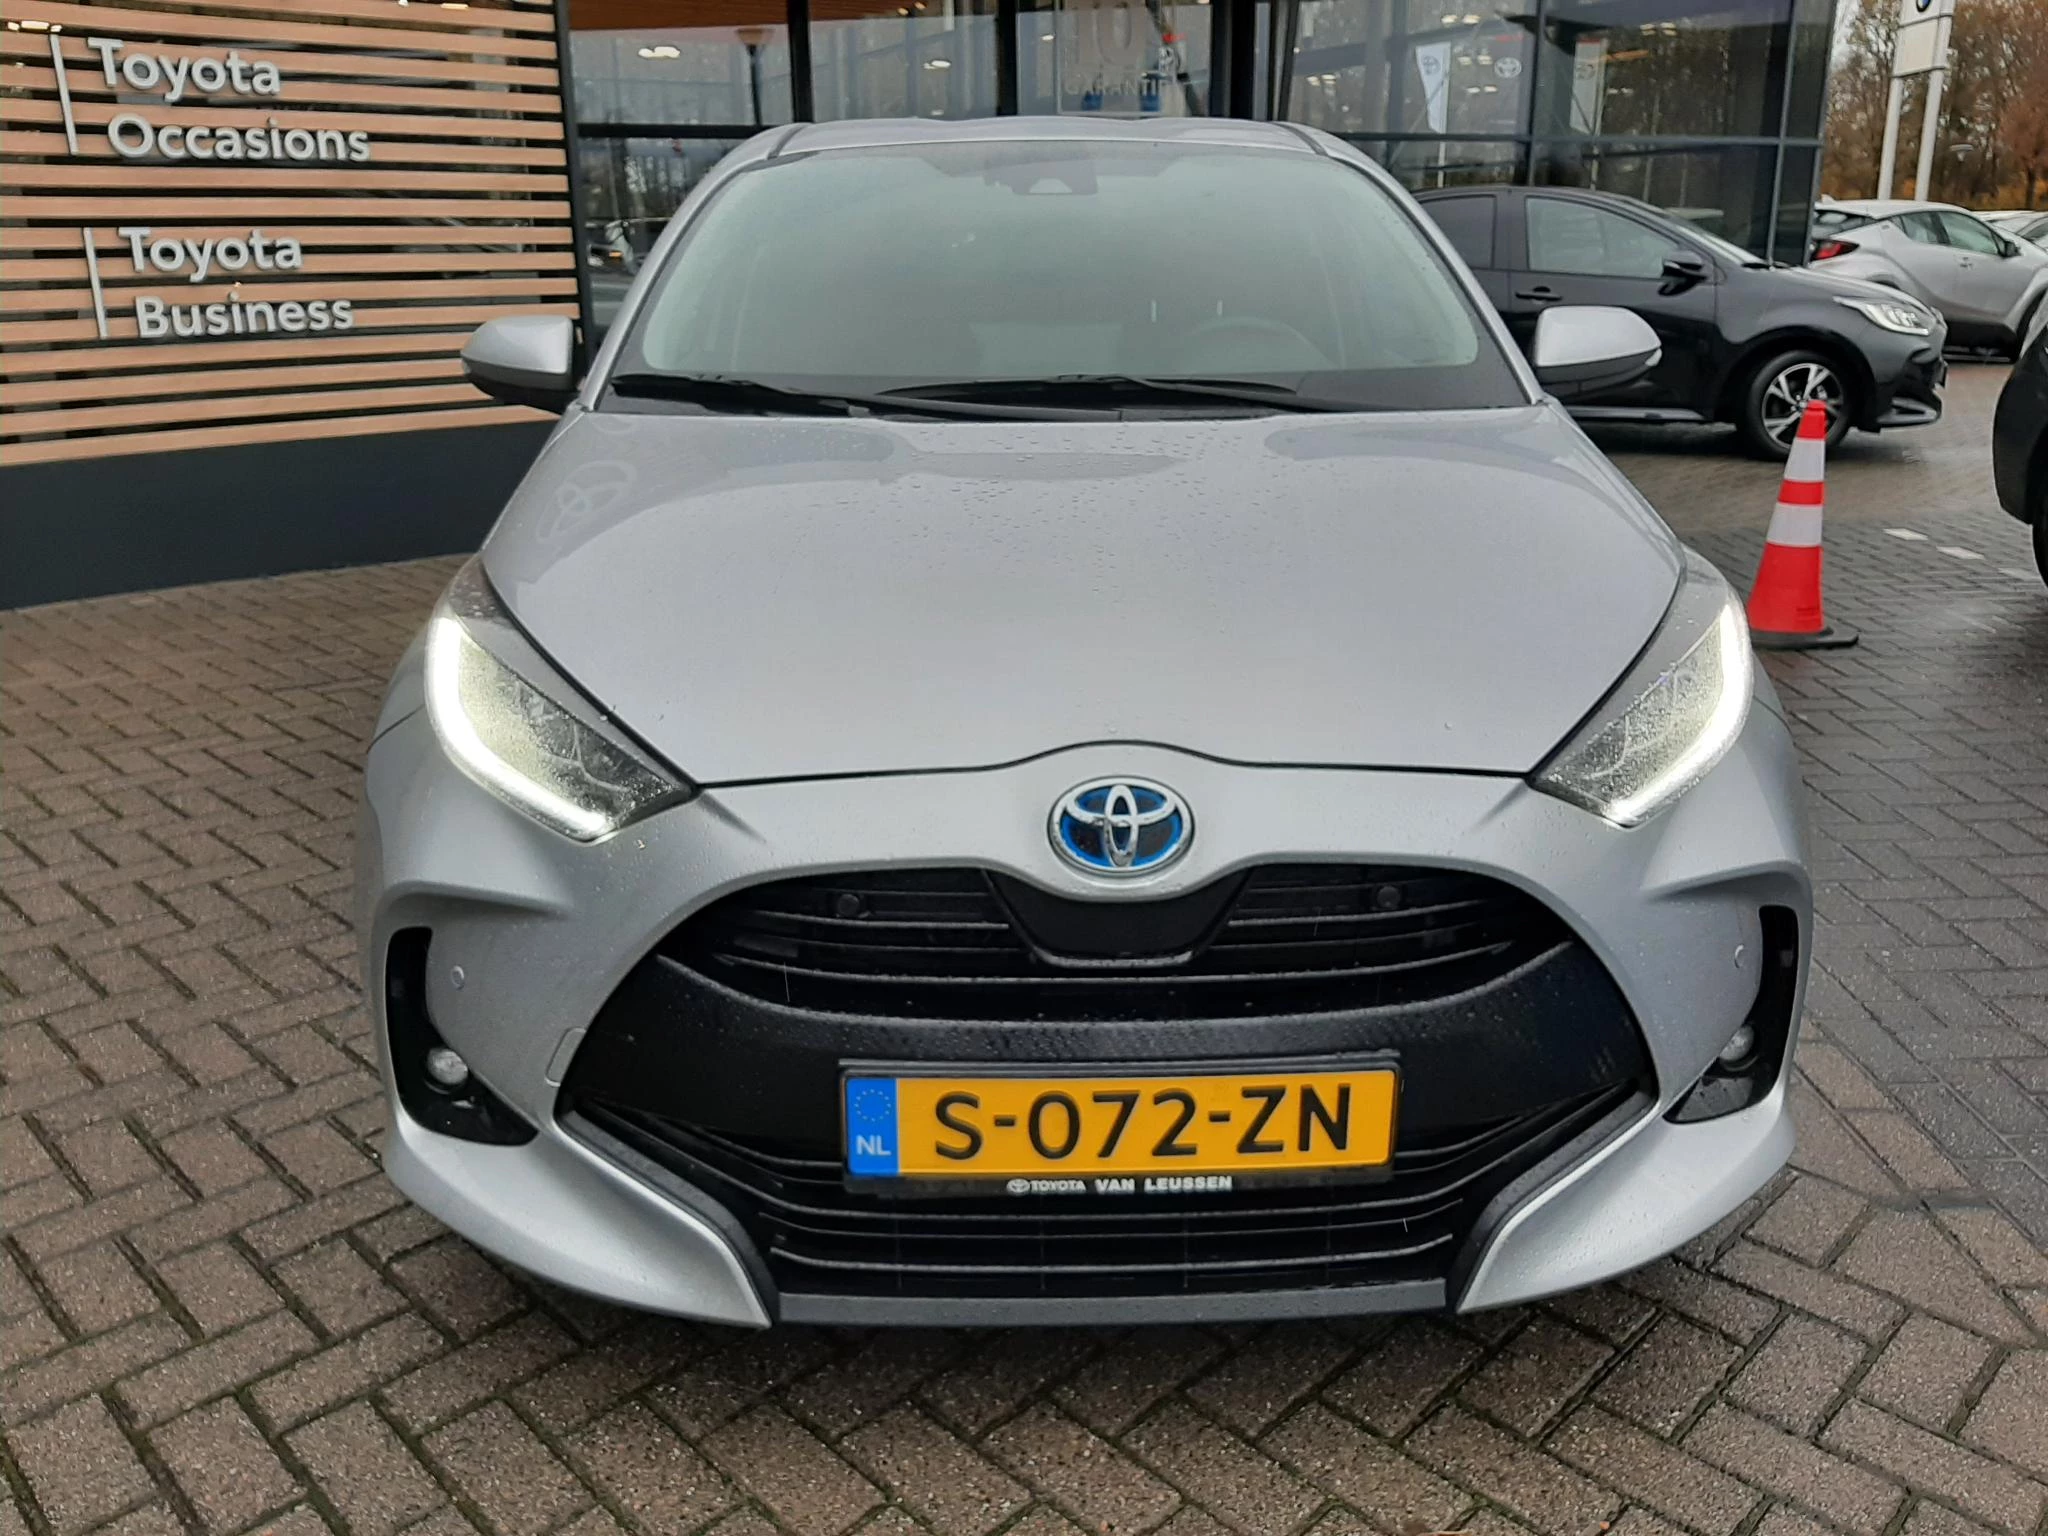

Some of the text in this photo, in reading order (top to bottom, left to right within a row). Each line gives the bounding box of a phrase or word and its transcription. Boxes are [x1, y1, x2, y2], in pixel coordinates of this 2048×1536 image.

[87, 37, 281, 102] Toyota
[108, 114, 371, 162] Occasions
[118, 226, 302, 283] Toyota
[136, 291, 354, 338] Business
[856, 1135, 892, 1156] NL
[934, 1084, 1352, 1160] S-072-ZN
[1029, 1175, 1233, 1194] TOYOTA VAN LEUSSEN
